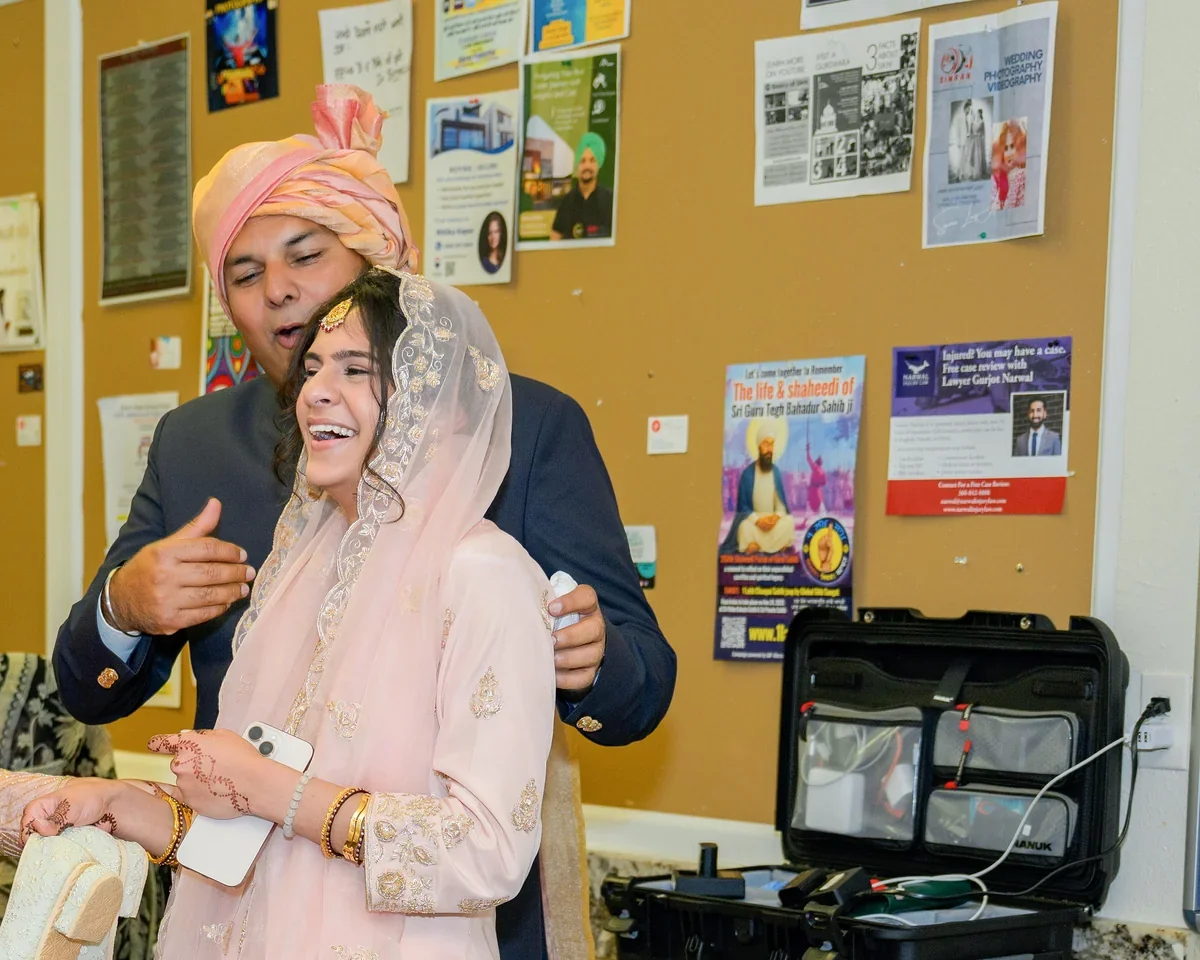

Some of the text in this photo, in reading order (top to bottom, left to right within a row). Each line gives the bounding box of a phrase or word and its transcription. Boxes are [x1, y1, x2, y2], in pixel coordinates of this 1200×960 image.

[878, 40, 896, 49] FACTS
[865, 43, 878, 71] 3
[1003, 49, 1044, 66] WEDDING
[984, 60, 1043, 81] PHOTOGRAPHY
[986, 72, 1043, 92] VIDEOGRAPHY
[942, 348, 974, 361] Injured?
[976, 347, 992, 359] You
[994, 349, 1012, 359] may
[1014, 345, 1036, 357] have
[1044, 346, 1066, 355] case.
[760, 370, 776, 378] come
[777, 368, 802, 379] together
[811, 365, 843, 375] Remember
[942, 359, 1028, 374] Free case review with
[734, 376, 855, 401] The life & shaheedi of
[942, 371, 1034, 389] Lawyer Gurjot Narwal
[731, 399, 853, 419] Sri Guru Tegh Bahadur Sahib ji
